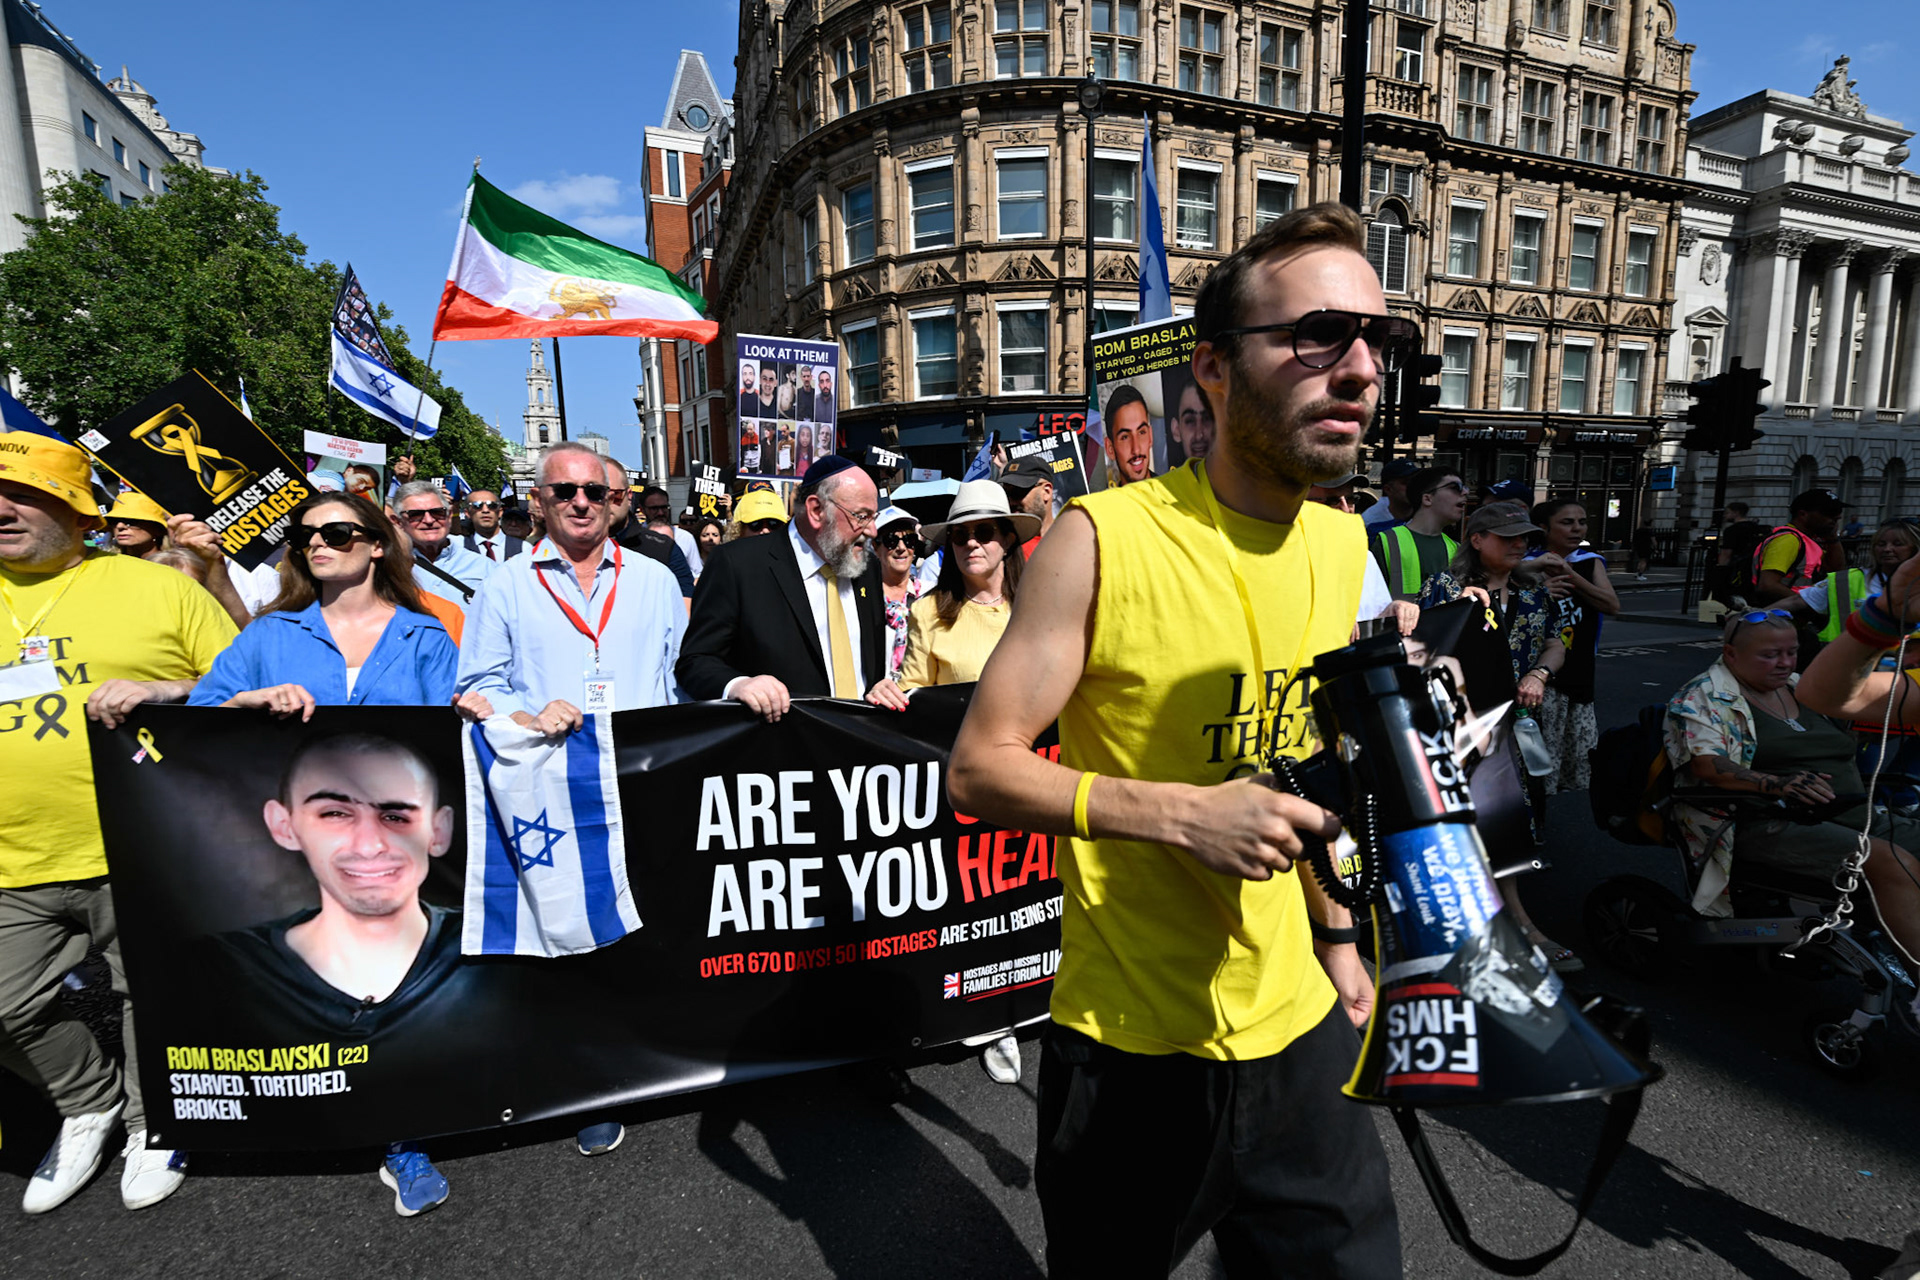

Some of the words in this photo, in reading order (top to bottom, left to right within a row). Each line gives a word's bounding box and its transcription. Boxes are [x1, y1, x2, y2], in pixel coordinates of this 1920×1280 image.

[745, 344, 776, 359] LOOK
[777, 347, 793, 360] AT
[793, 349, 829, 363] THEM!
[1093, 339, 1126, 358] ROM
[1095, 355, 1136, 371] STARVED
[1143, 346, 1173, 361] CAGED
[1106, 370, 1119, 380] BY
[1121, 365, 1145, 377] YOUR
[1146, 357, 1180, 371] HEROES
[1181, 354, 1190, 363] IN
[1010, 441, 1042, 459] HAMAS
[1042, 436, 1059, 450] ARE
[1497, 429, 1527, 441] NERO
[1609, 433, 1638, 444] NERO
[703, 465, 721, 481] LET
[205, 484, 267, 533] RELEASE
[258, 467, 290, 493] THE
[695, 478, 725, 498] THEM
[220, 480, 309, 555] HOSTAGES
[1558, 597, 1575, 616] ET
[1561, 607, 1582, 627] EM
[1202, 714, 1312, 763] THE
[1420, 729, 1468, 813] FCK
[696, 771, 816, 851] ARE
[828, 761, 940, 841] YOU
[707, 857, 825, 938] ARE
[837, 838, 949, 922] YOU
[957, 828, 1058, 904] HEA
[1405, 862, 1428, 895] Shani
[1416, 897, 1436, 925] Louk
[700, 954, 744, 978] OVER
[747, 952, 781, 974] 670
[784, 946, 831, 972] DAYS!
[835, 943, 857, 965] 50
[860, 929, 938, 960] HOSTAGES
[939, 923, 969, 946] ARE
[971, 914, 1009, 940] STILL
[1010, 902, 1046, 932] BEING
[963, 963, 998, 980] HOSTAGES
[998, 960, 1013, 972] AND
[1014, 954, 1041, 969] MISSING
[963, 973, 1007, 995] FAMILIES
[1008, 964, 1041, 985] FORUM
[1387, 998, 1477, 1038] HMS
[166, 1046, 210, 1070] ROM
[211, 1043, 330, 1072] BRASLAVSKI
[337, 1045, 369, 1067] (22)
[1386, 1036, 1479, 1074] FCK
[169, 1073, 250, 1097] STARVED.
[250, 1070, 351, 1098] TORTURED.
[173, 1098, 248, 1121] BROKEN.
